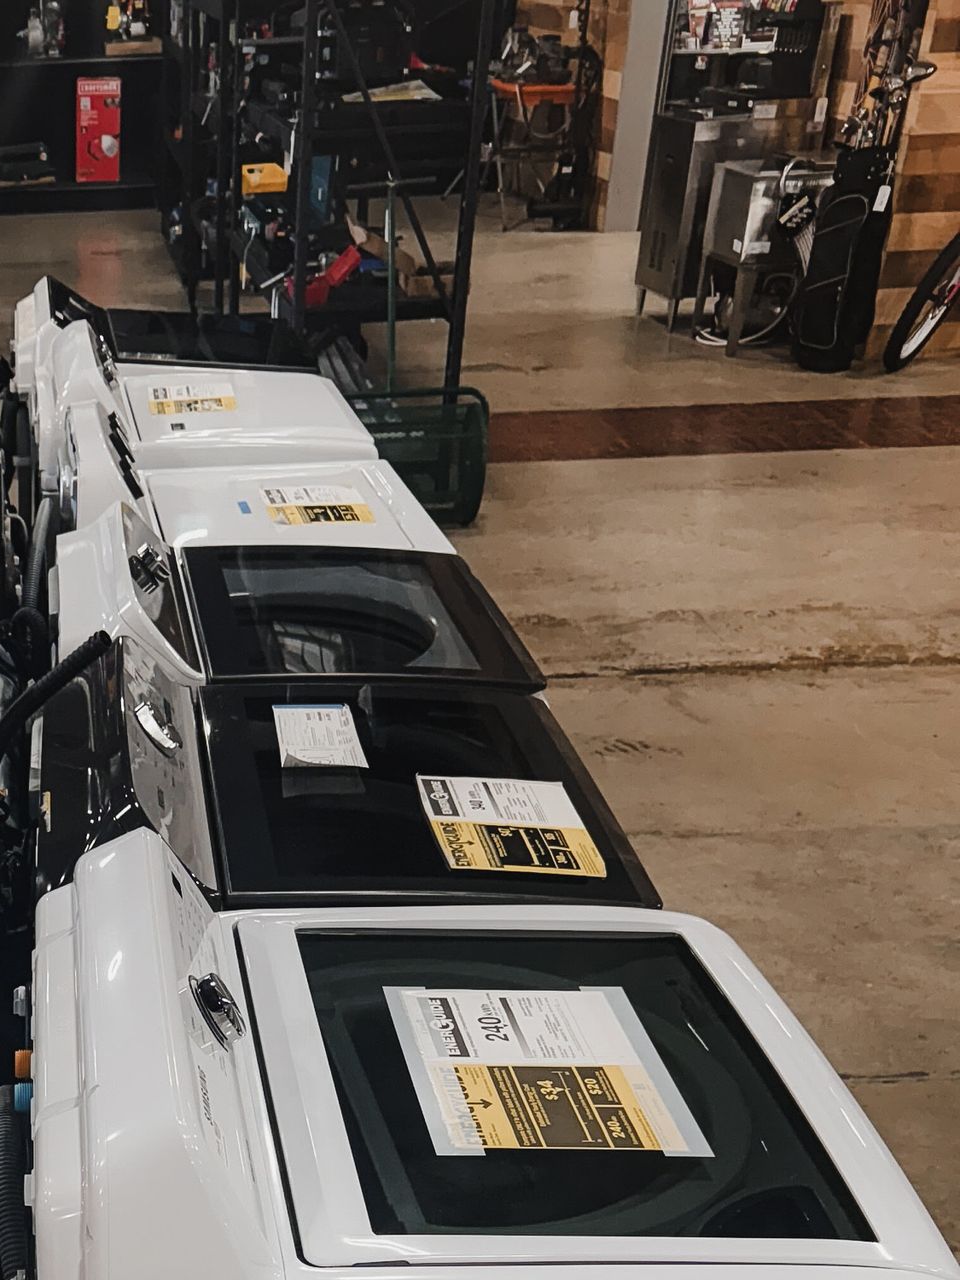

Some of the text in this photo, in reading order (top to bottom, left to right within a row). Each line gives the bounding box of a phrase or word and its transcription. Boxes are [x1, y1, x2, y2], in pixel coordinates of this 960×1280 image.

[478, 1017, 509, 1042] 240
[537, 1080, 559, 1100] $34
[584, 1078, 603, 1095] $20
[607, 1121, 626, 1138] 240
